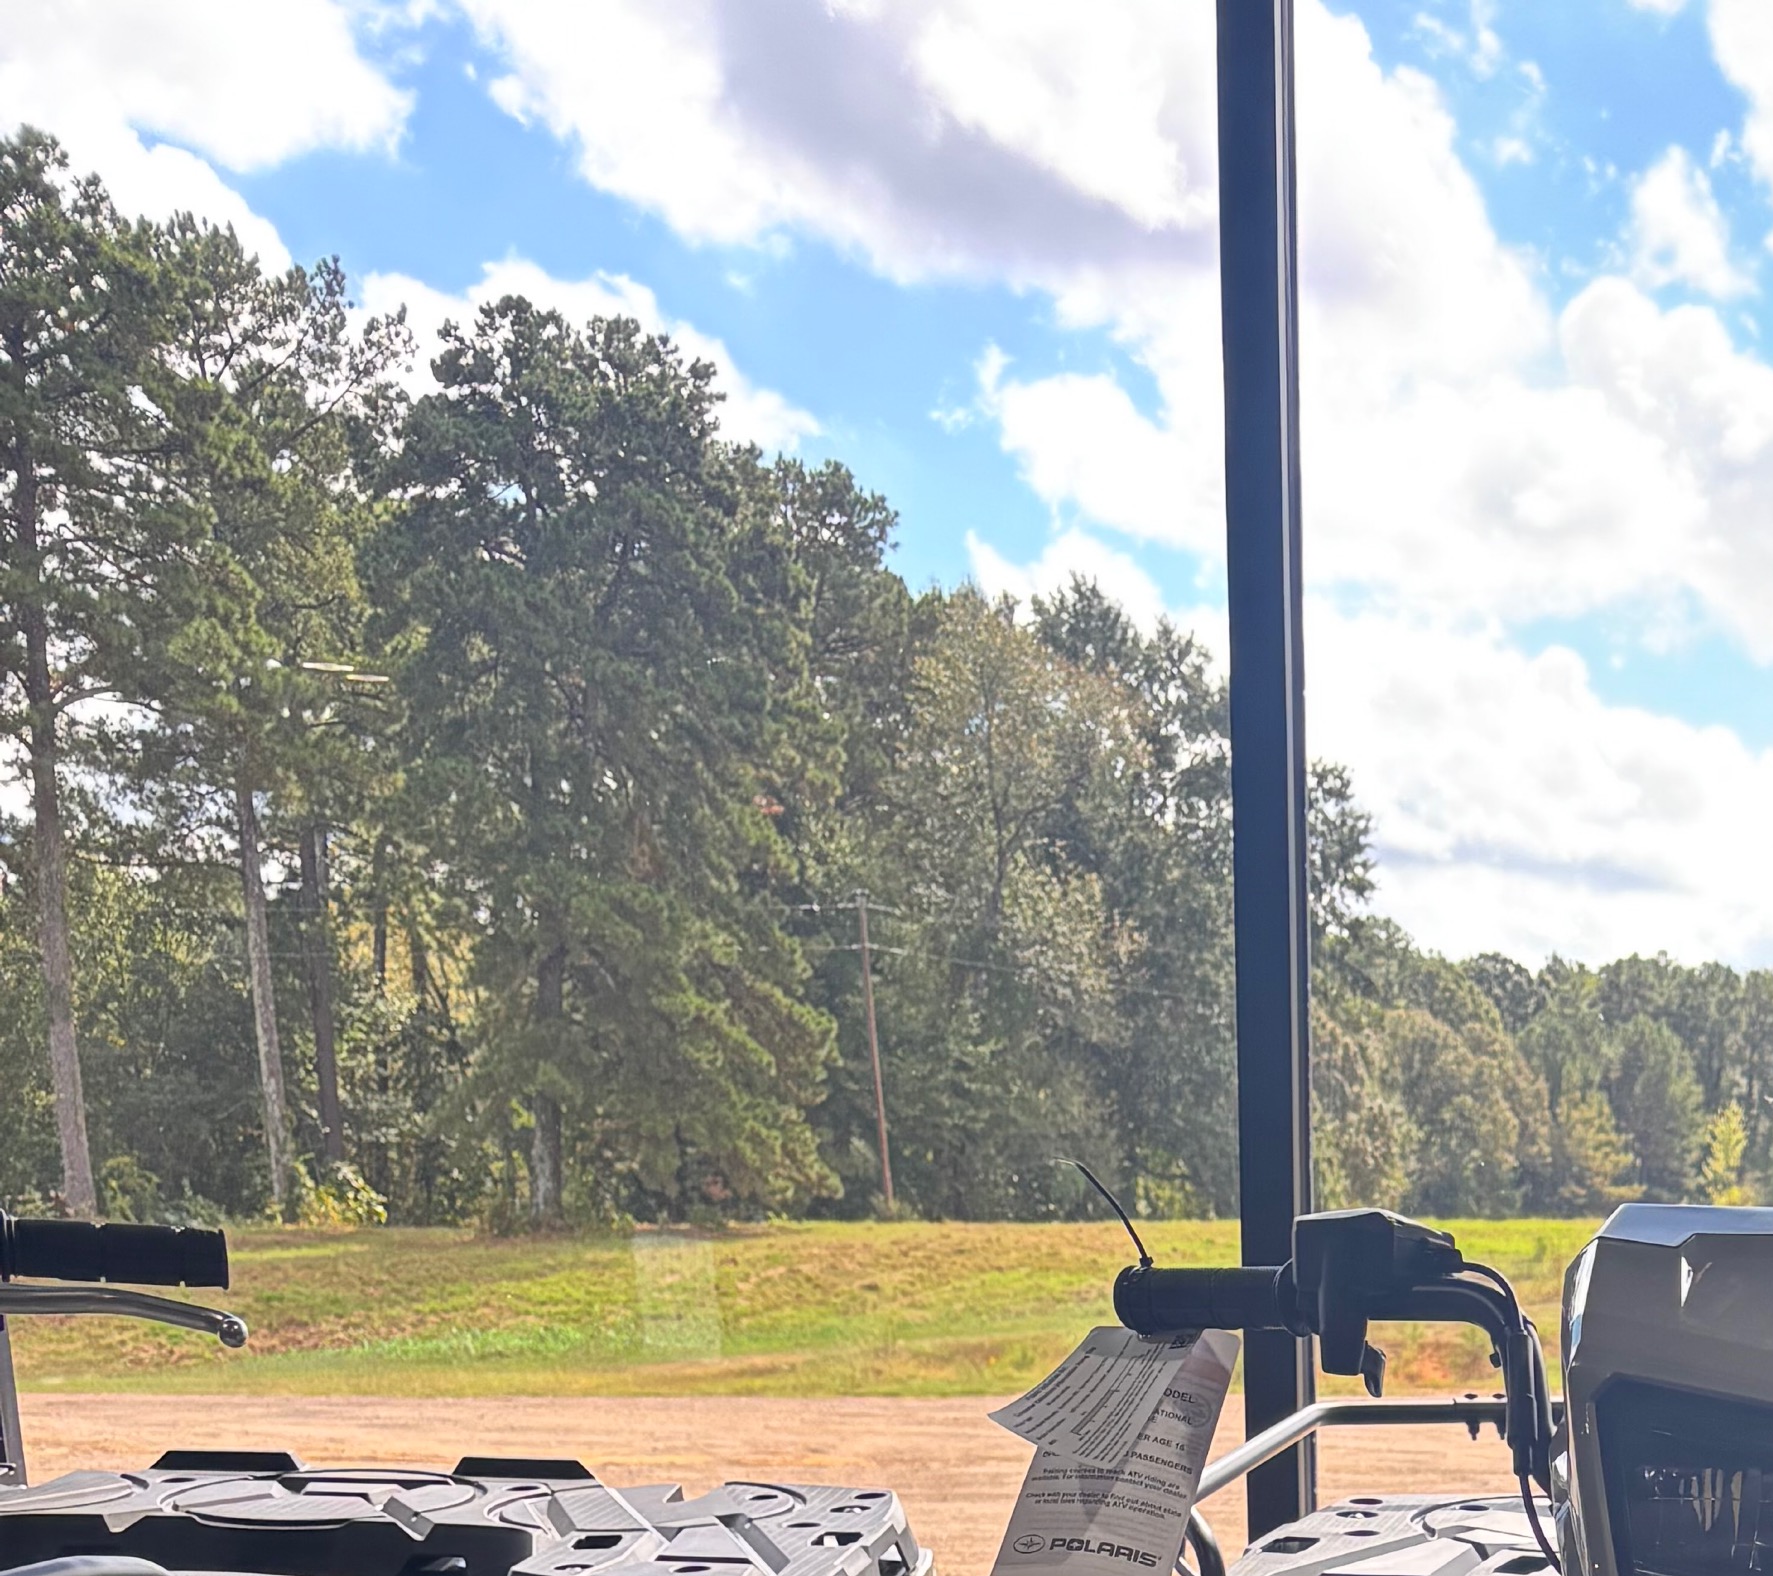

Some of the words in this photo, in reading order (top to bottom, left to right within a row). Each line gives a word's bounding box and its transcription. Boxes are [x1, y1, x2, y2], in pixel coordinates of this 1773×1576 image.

[1163, 1388, 1196, 1404] ODEL
[1152, 1408, 1193, 1425] ATIONAL
[1152, 1436, 1173, 1447] AGE
[1175, 1443, 1185, 1451] 16
[1130, 1450, 1193, 1475] PASSENGERS
[1128, 1470, 1144, 1478] ATV
[1112, 1500, 1129, 1509] ATV
[1049, 1538, 1157, 1568] POLARIS
